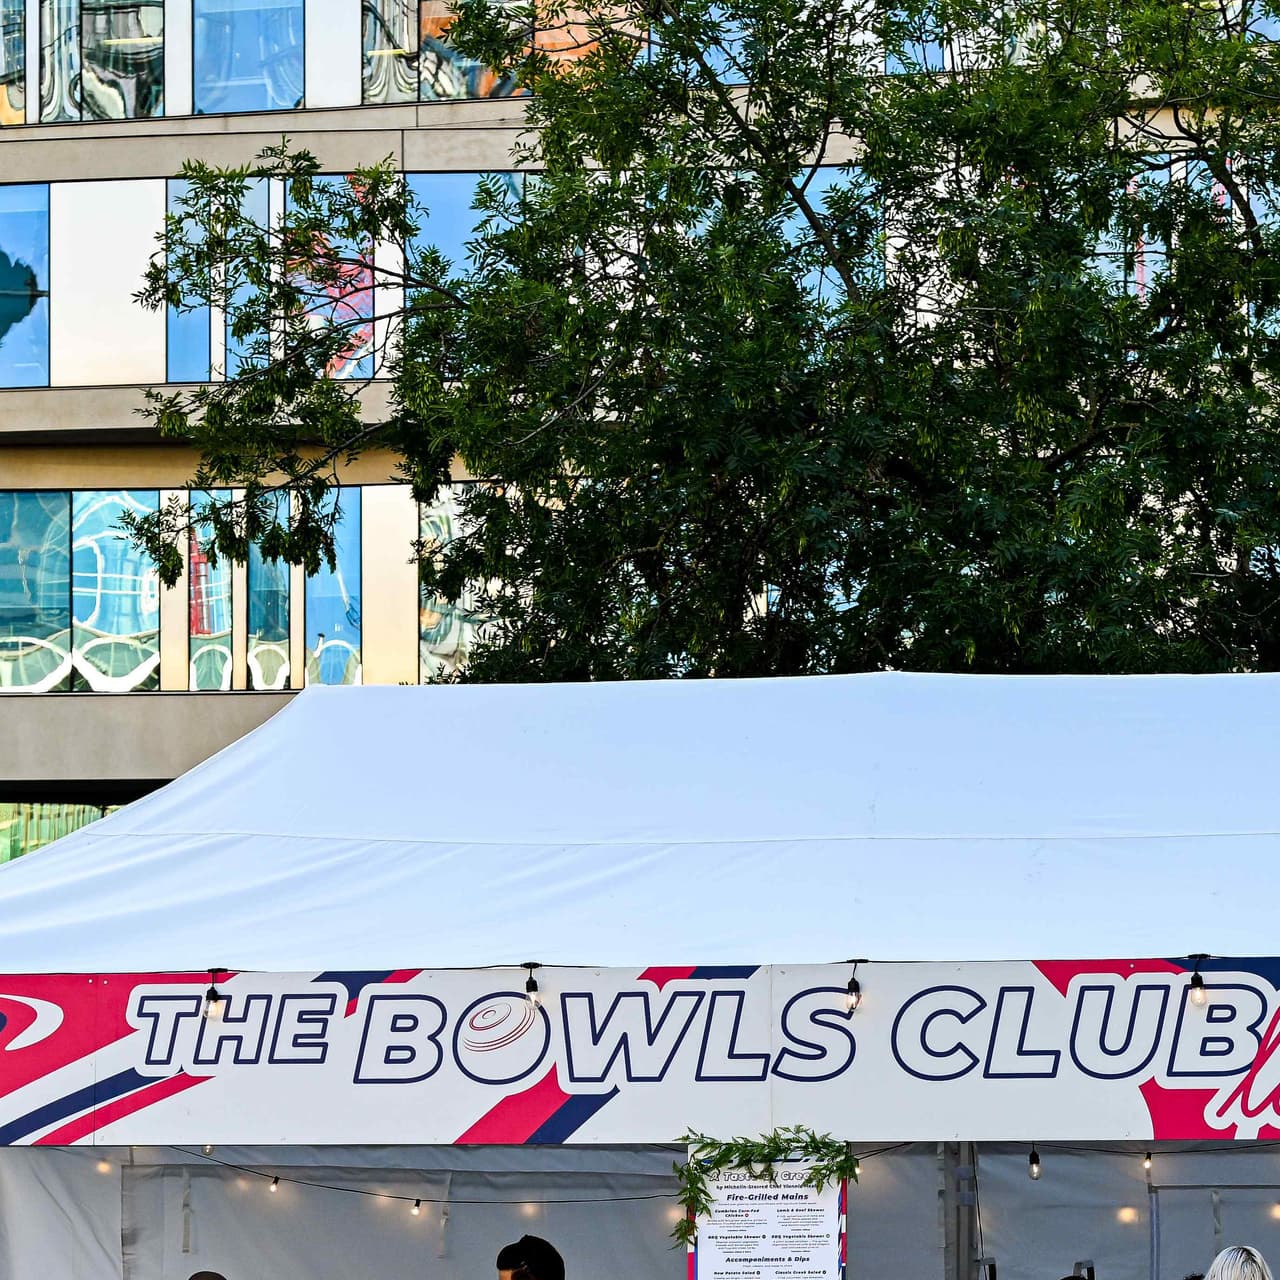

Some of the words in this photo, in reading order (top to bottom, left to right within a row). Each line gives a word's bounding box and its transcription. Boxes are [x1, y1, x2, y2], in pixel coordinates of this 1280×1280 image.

[137, 992, 335, 1066] THE
[352, 985, 858, 1086] BOWLS
[890, 982, 1268, 1082] CLUB
[727, 1193, 778, 1201] Fire-Grilled
[782, 1193, 808, 1201] Mains
